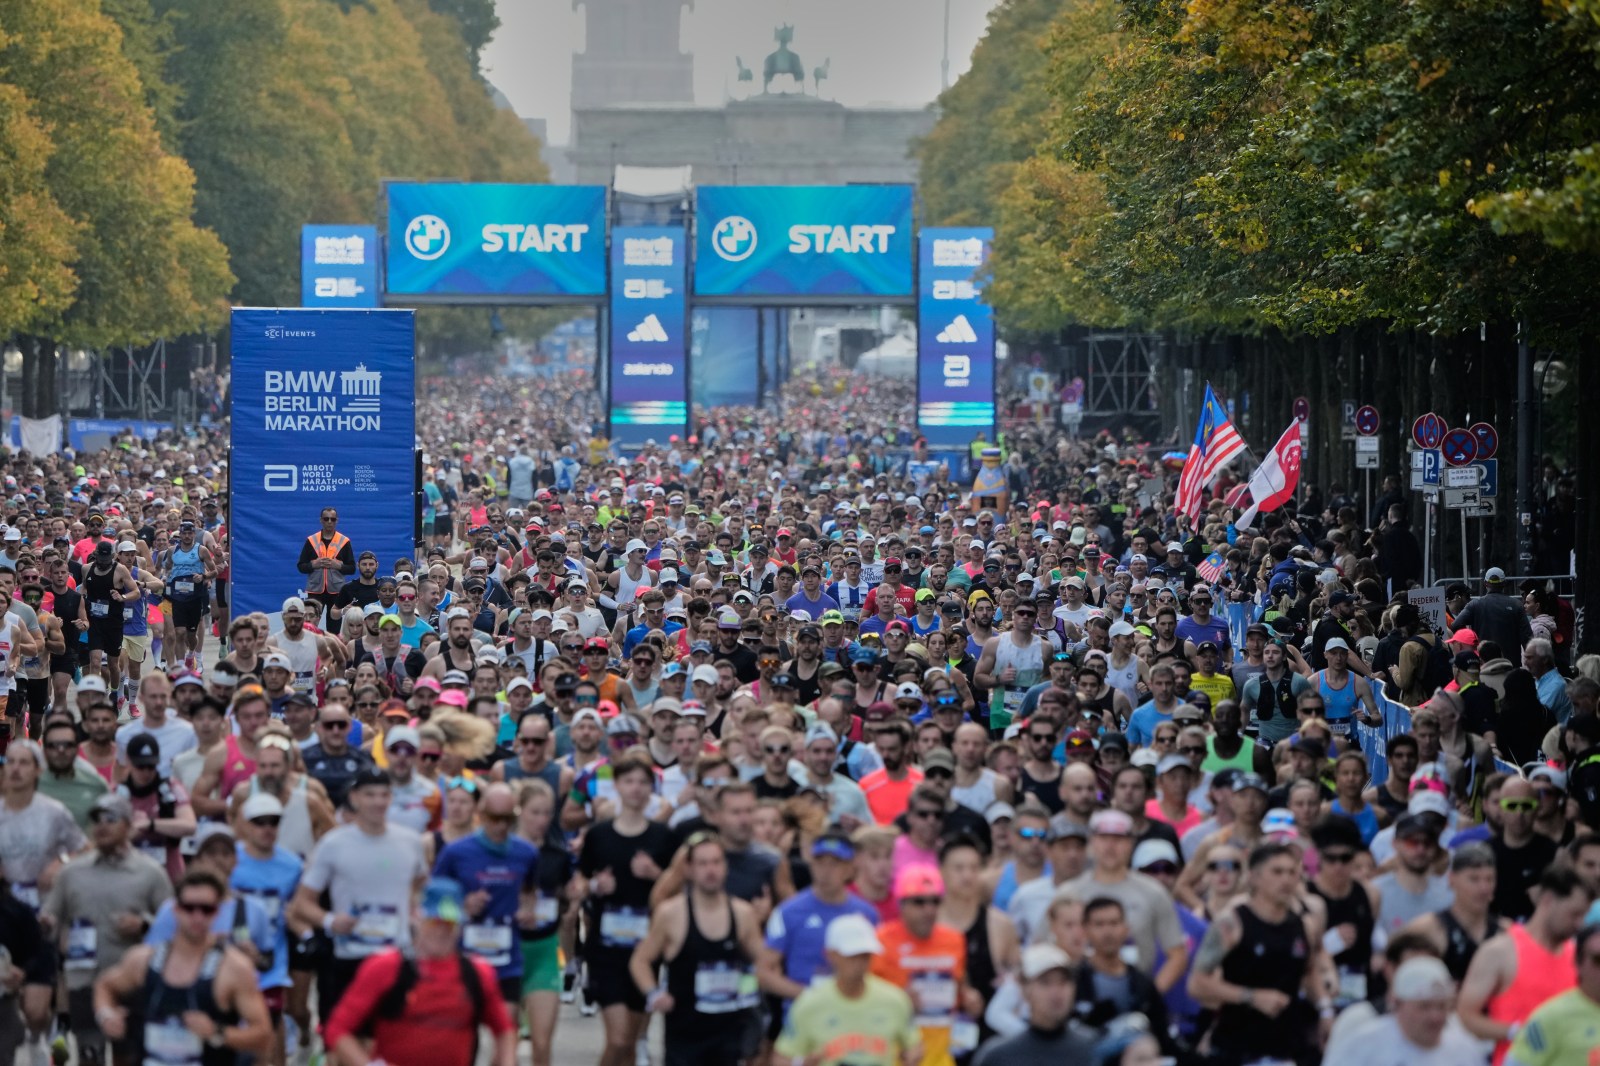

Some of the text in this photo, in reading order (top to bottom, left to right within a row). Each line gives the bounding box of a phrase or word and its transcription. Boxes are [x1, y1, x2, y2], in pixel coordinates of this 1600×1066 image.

[482, 224, 588, 252] START
[789, 225, 895, 253] START
[265, 329, 280, 339] SCC
[265, 371, 336, 392] BMW
[265, 396, 336, 412] BERLIN
[265, 415, 380, 431] MARATHON
[1425, 453, 1434, 479] P
[1410, 595, 1440, 606] FREDERIK
